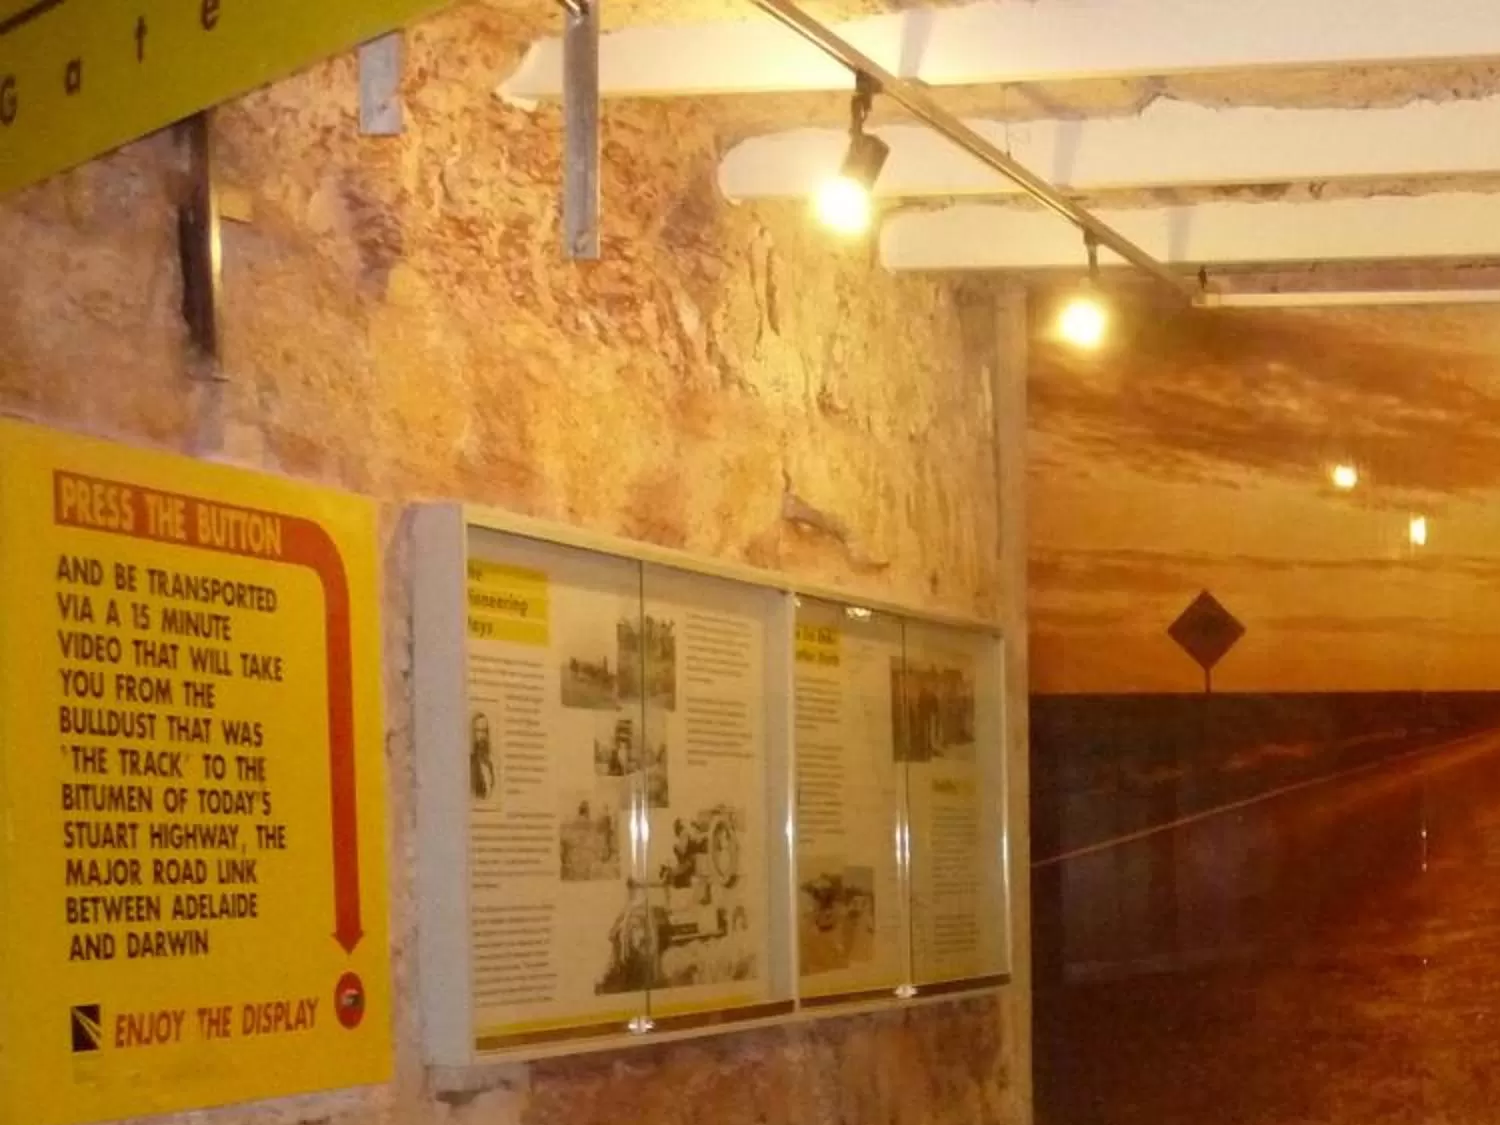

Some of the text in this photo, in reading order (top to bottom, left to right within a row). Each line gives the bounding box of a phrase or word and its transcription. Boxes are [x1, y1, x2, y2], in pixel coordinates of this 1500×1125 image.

[60, 480, 282, 555] PRESS THE BUTTON
[57, 555, 278, 613] AND BE TRANSPORTED
[56, 593, 232, 641] VIA A 15 MINUTE
[57, 630, 283, 682] VIDEO THAT WILL TAKE
[59, 668, 215, 708] YOU FROM THE
[60, 706, 264, 748] BULLDUST THAT WAS
[202, 753, 226, 781] TO
[235, 755, 266, 782] THE
[61, 783, 271, 816] BITUMEN OF TODAY'S
[64, 821, 139, 849] STUART
[256, 824, 287, 849] THE
[65, 859, 257, 886] MAJOR ROAD LINK
[66, 893, 258, 925] BETWEEN ADELAIDE
[69, 930, 209, 961] AND DARWIN
[115, 998, 320, 1049] ENJOY THE DISPLAY
